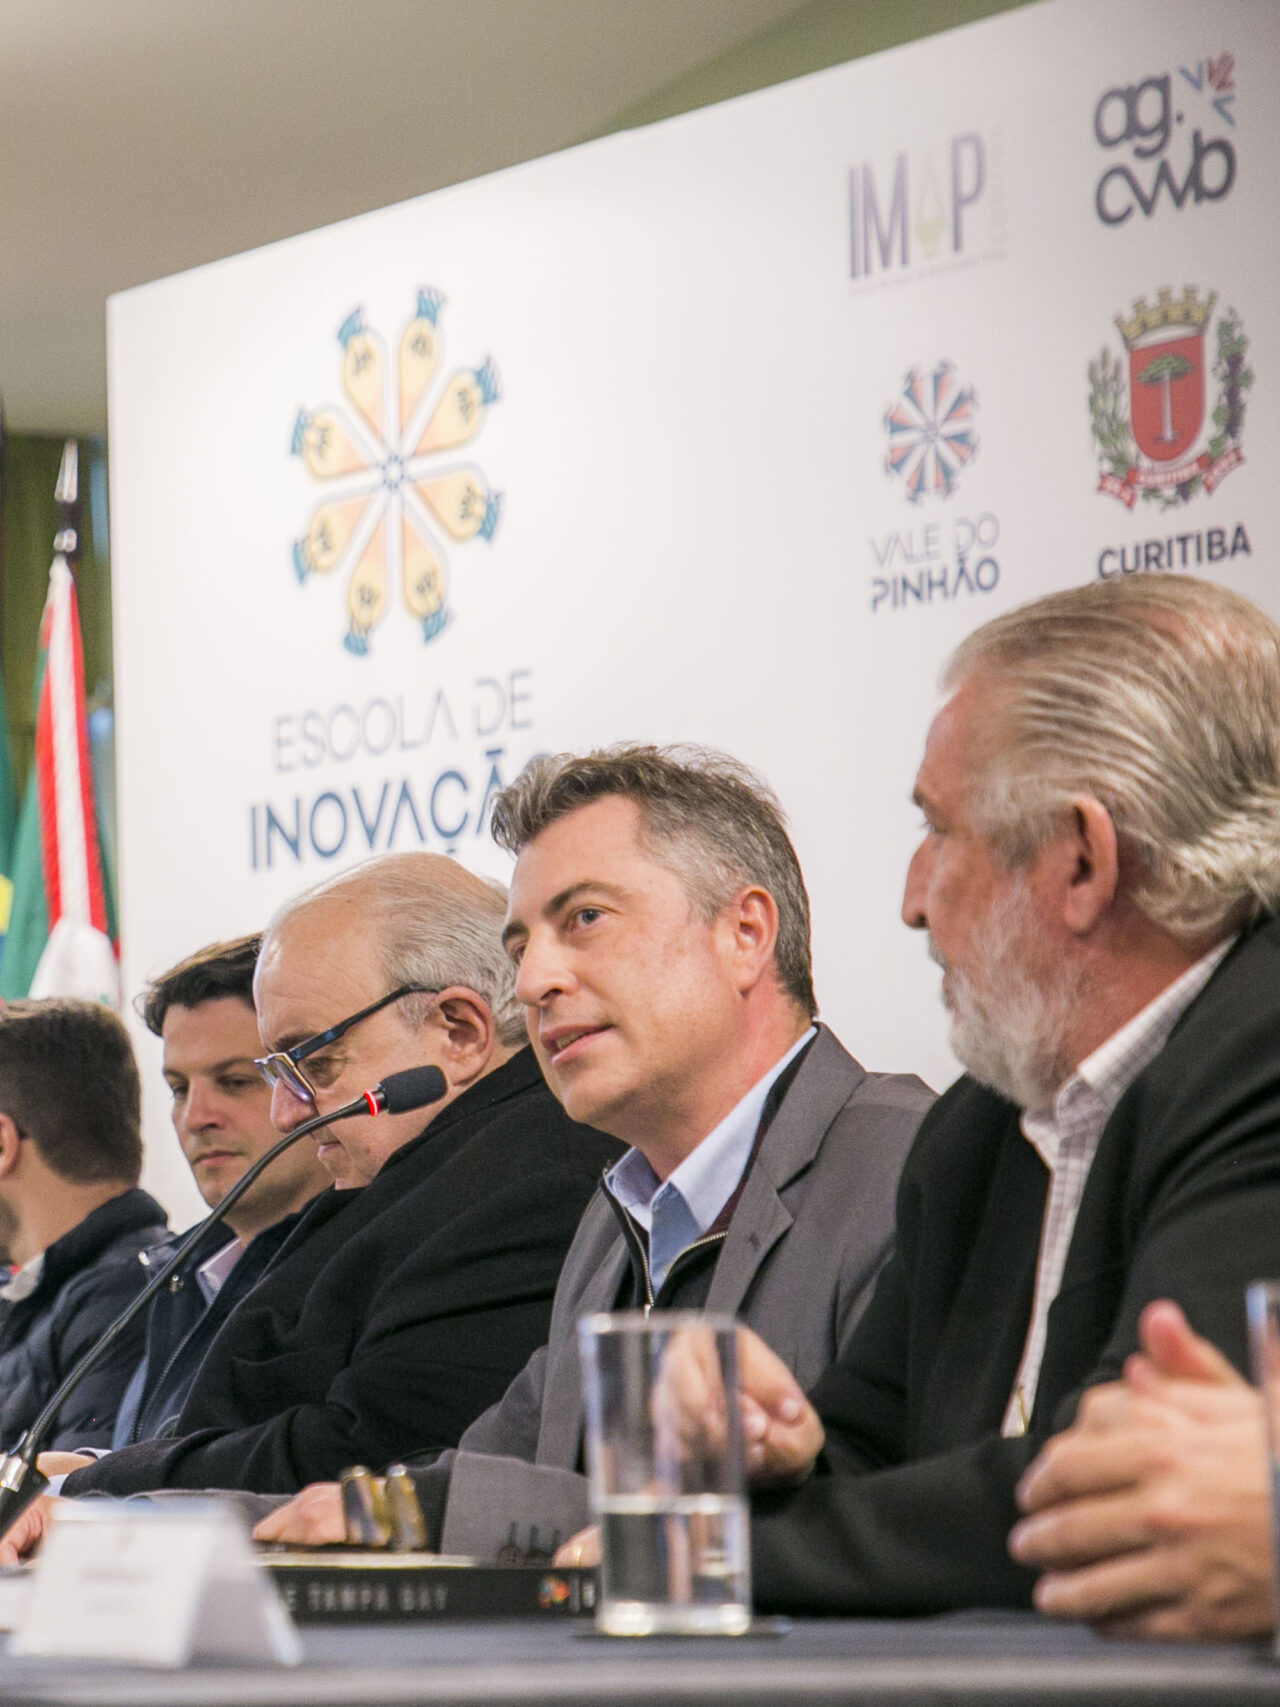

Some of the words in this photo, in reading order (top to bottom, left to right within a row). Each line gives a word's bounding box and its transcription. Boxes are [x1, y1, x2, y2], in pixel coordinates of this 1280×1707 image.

[1093, 129, 1238, 228] cwb
[870, 520, 940, 568] VALE
[955, 511, 1001, 553] DO
[1097, 522, 1254, 580] CURITIBA
[871, 552, 1001, 613] PINHÃO
[273, 687, 458, 774] ESCOLA
[474, 668, 534, 738] DE
[249, 746, 555, 872] INOVAÇÃ
